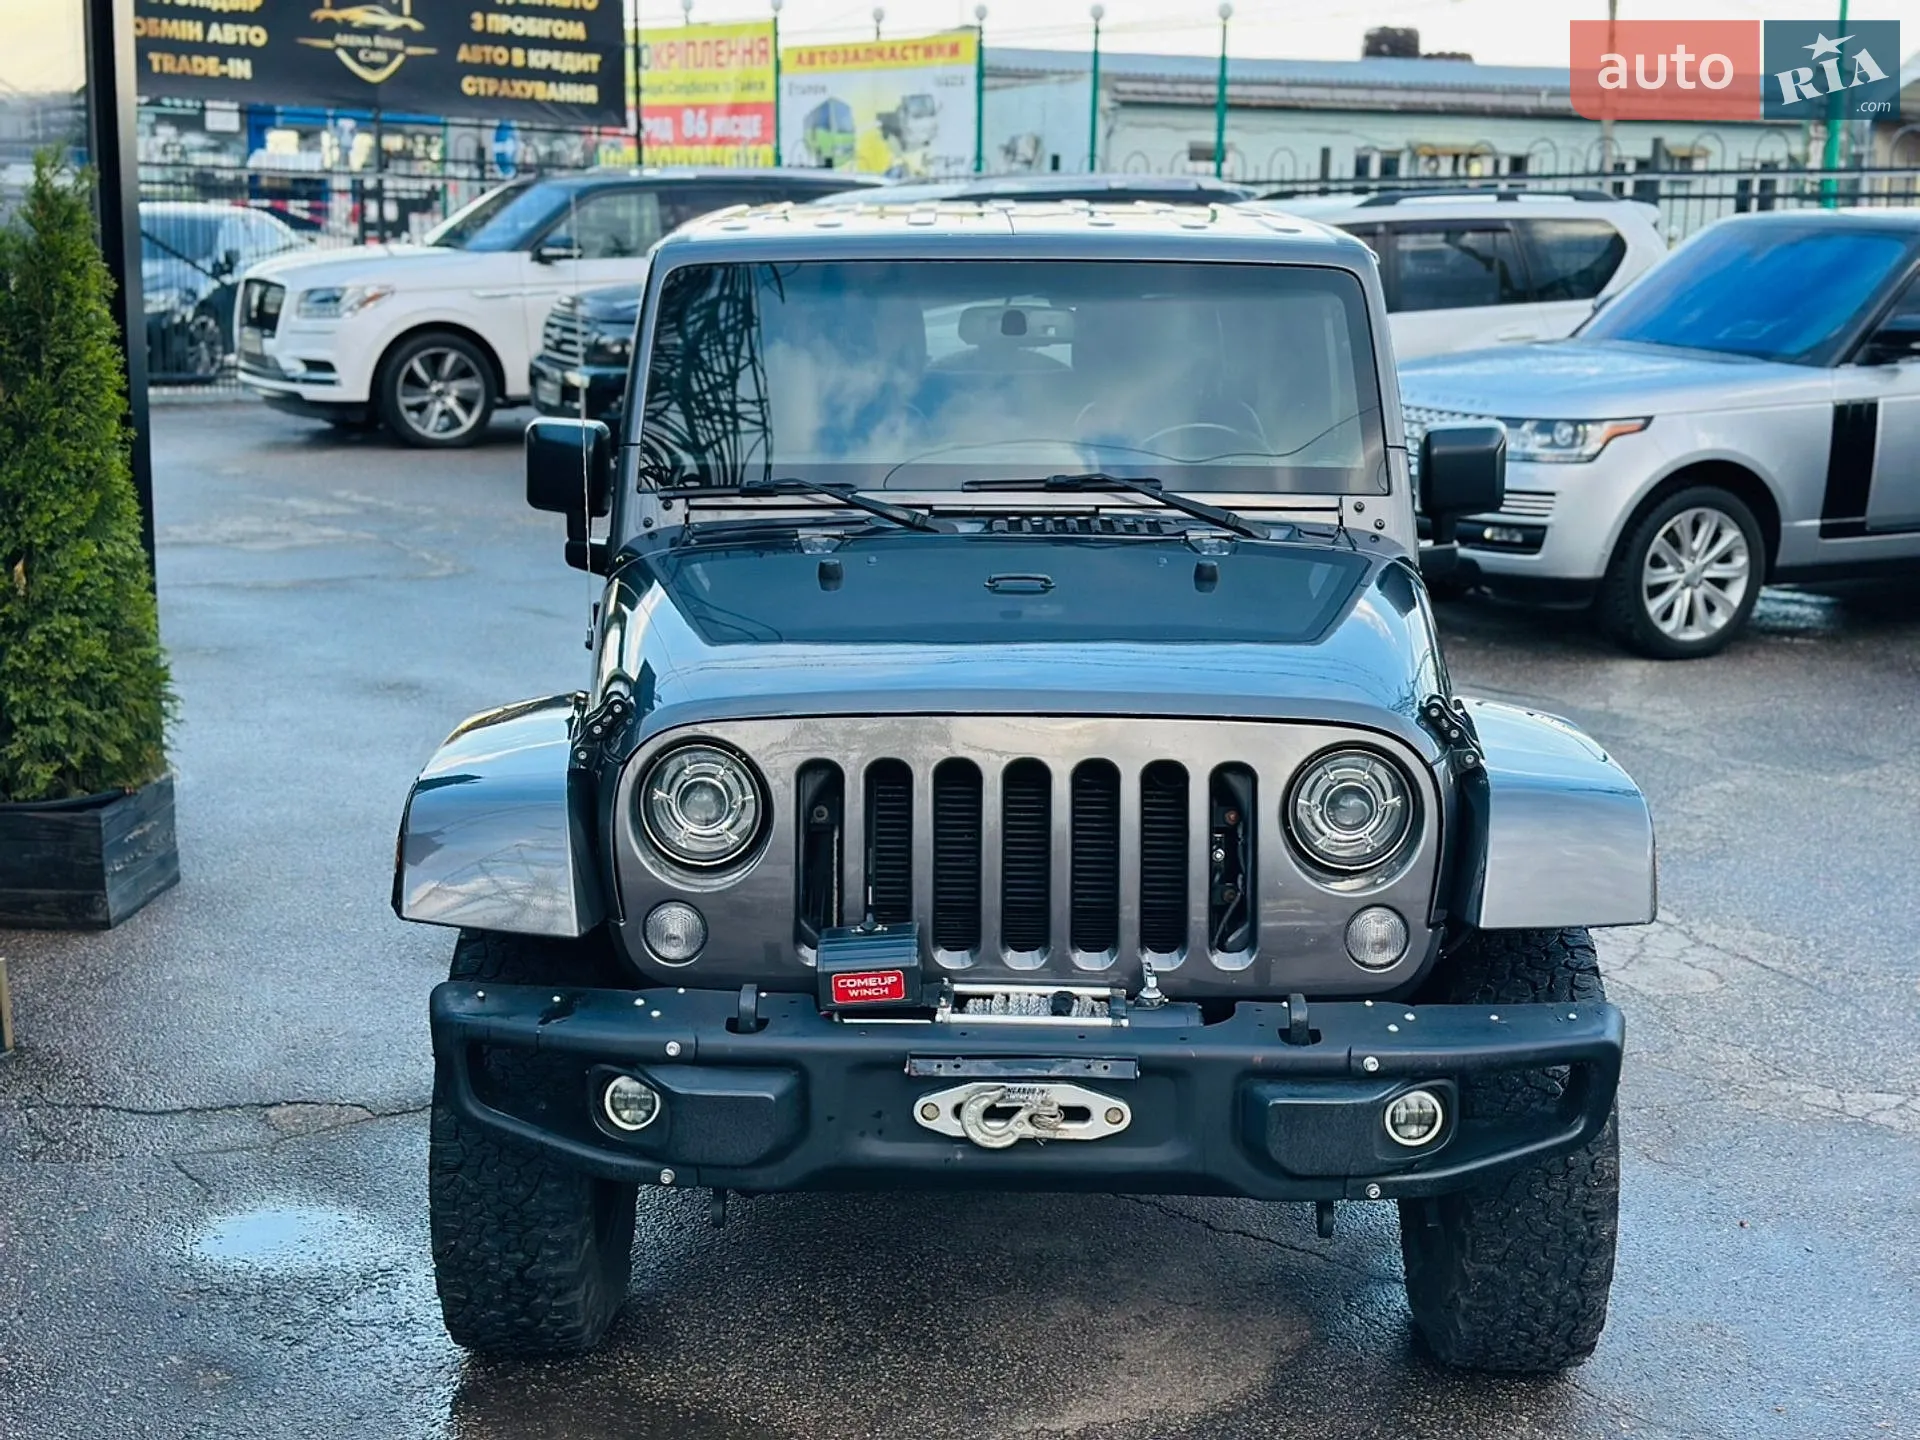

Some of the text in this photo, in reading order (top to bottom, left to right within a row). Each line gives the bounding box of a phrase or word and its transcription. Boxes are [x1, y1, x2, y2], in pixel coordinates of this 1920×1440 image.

[134, 16, 268, 47] ОБМІН АВТО
[485, 13, 588, 42] ПРОБІГОМ
[147, 51, 252, 80] TRADE-IN
[456, 43, 510, 66] АВТО
[527, 48, 602, 74] КРЕДИТ
[795, 42, 961, 67] АВТОЗАПЧАСТИНИ
[460, 75, 599, 104] СТРАХУВАННЯ
[838, 976, 898, 988] COMEUP
[848, 987, 889, 997] WINCH
